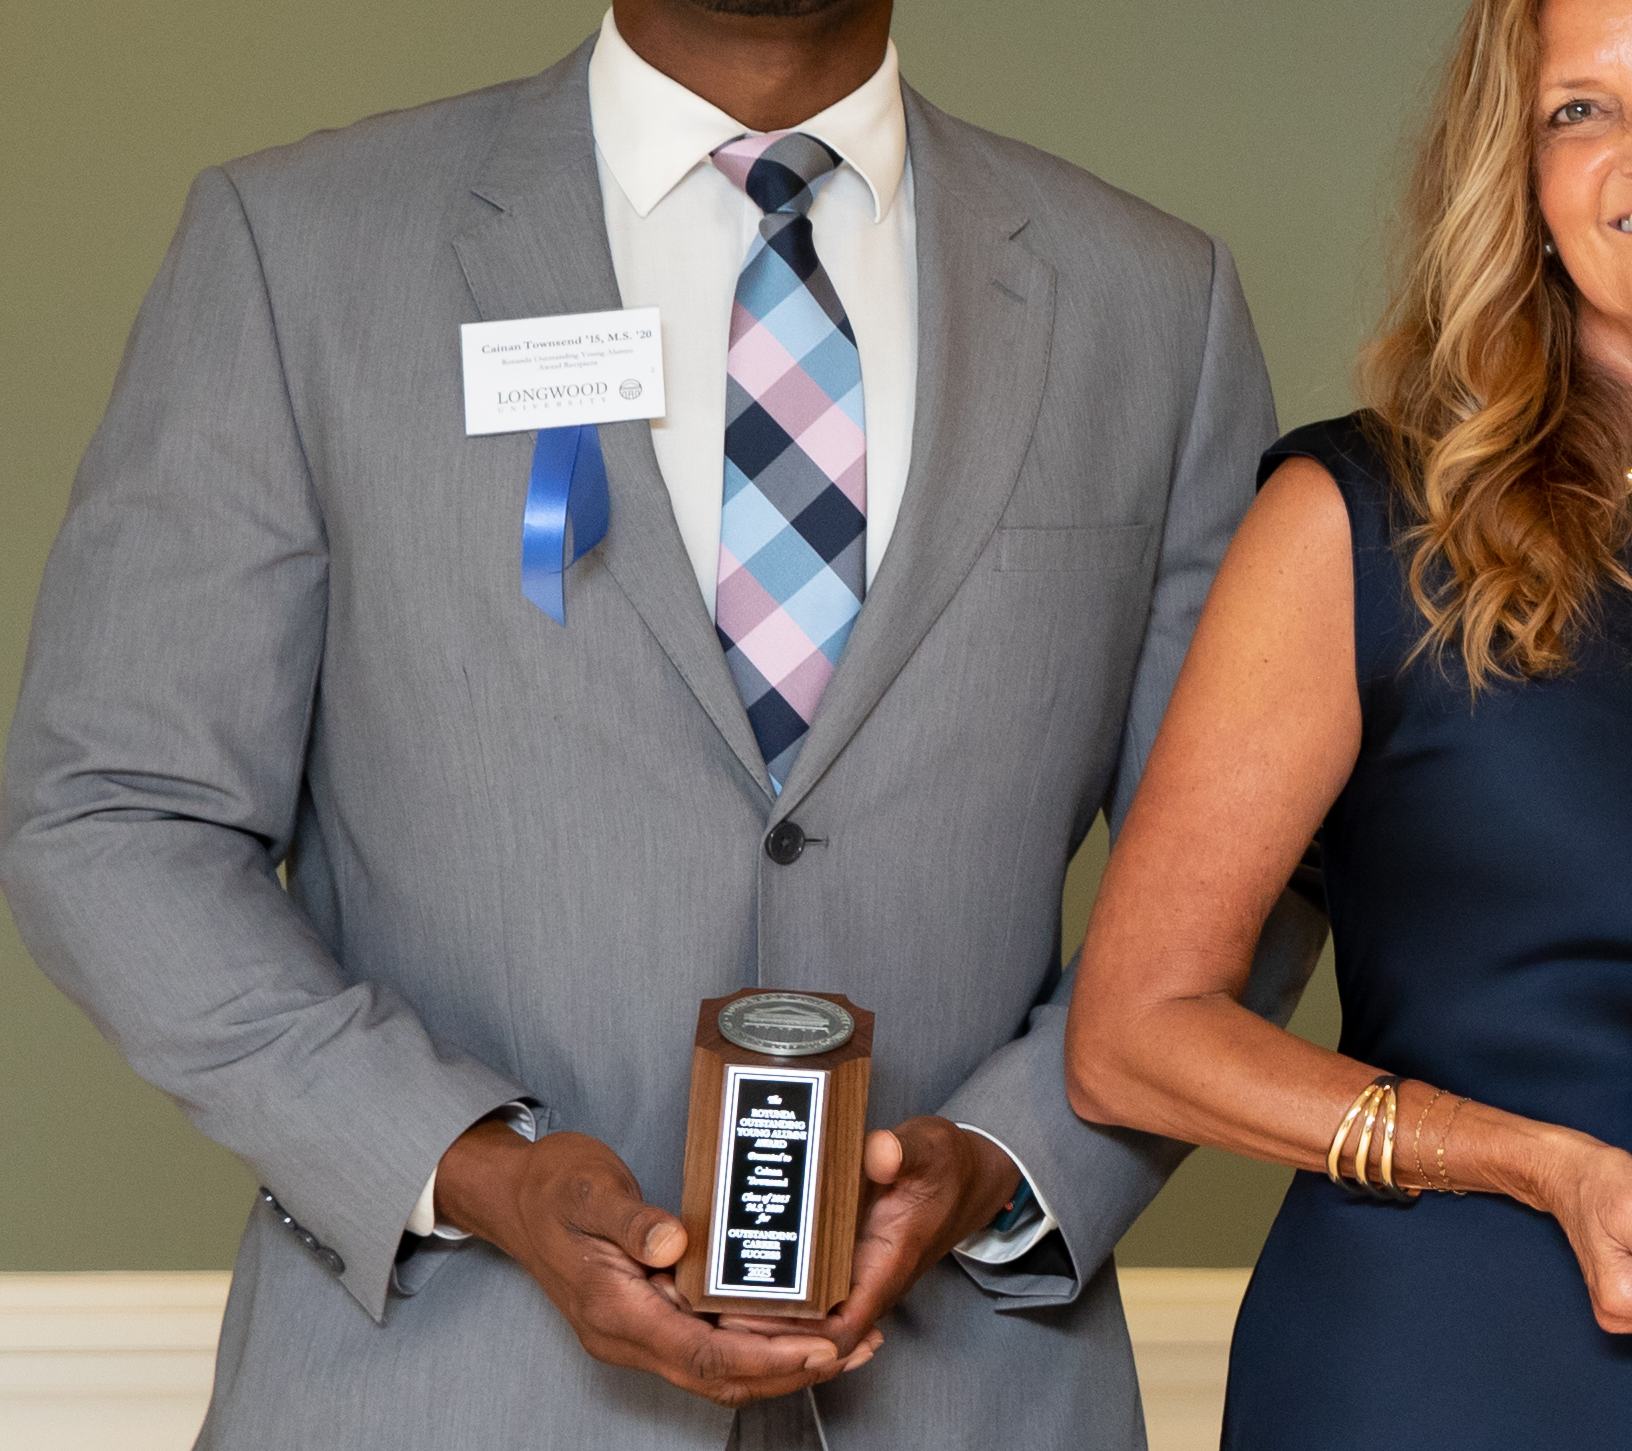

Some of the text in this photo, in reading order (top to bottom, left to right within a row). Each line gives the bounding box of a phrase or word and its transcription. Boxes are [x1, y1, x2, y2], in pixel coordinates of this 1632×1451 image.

[481, 329, 652, 354] Cainan Townsend '15, M.S. '20
[497, 381, 608, 405] LONGWOOD
[498, 398, 606, 413] UNIVERSITY
[751, 1108, 796, 1120] ROTUNDA
[739, 1118, 806, 1130] OUTSTANDING
[737, 1127, 807, 1140] YOUNG ALUMNI
[727, 1229, 798, 1241] OUTSTANDING
[747, 1267, 771, 1278] 2025
